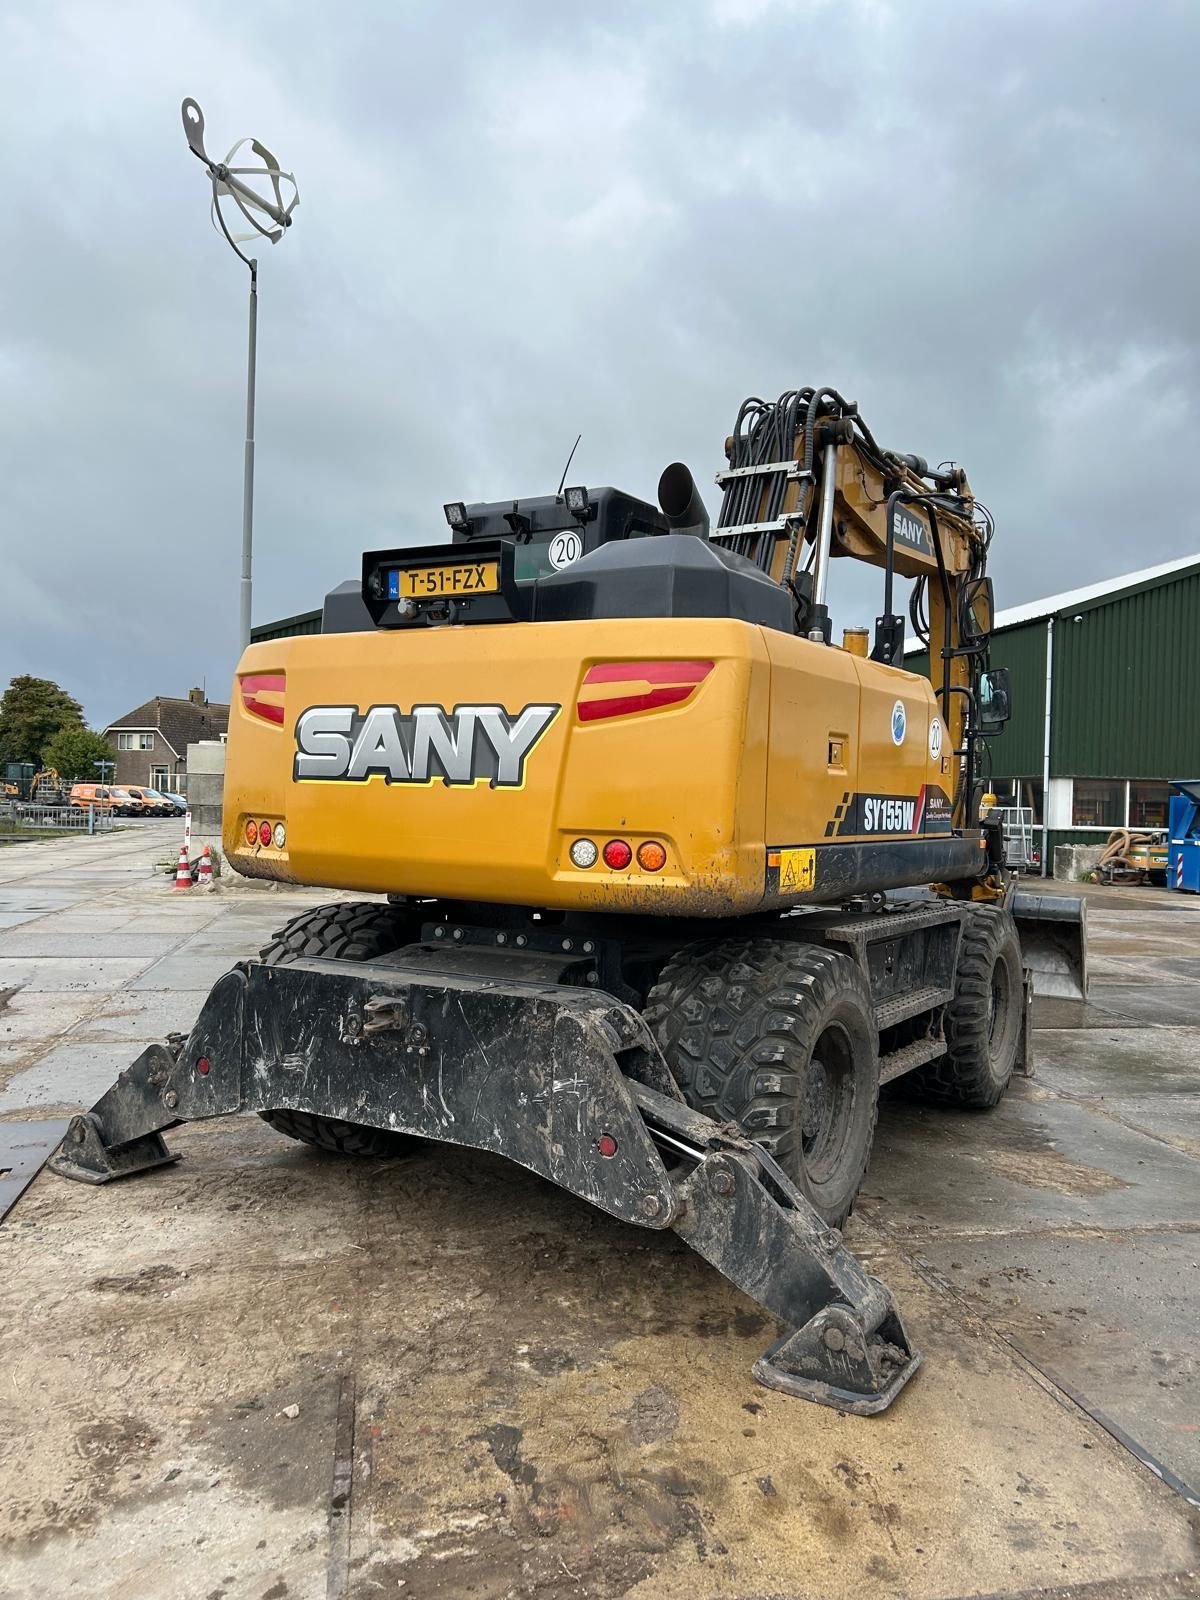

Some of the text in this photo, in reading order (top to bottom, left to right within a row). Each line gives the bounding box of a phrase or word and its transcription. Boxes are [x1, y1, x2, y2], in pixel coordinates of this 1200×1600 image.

[893, 512, 923, 545] SANY
[556, 536, 576, 562] 20
[409, 566, 486, 593] T-51-FZX
[294, 704, 561, 787] SANY
[931, 725, 940, 751] 20
[864, 797, 915, 831] SY155W
[929, 798, 944, 809] SANY
